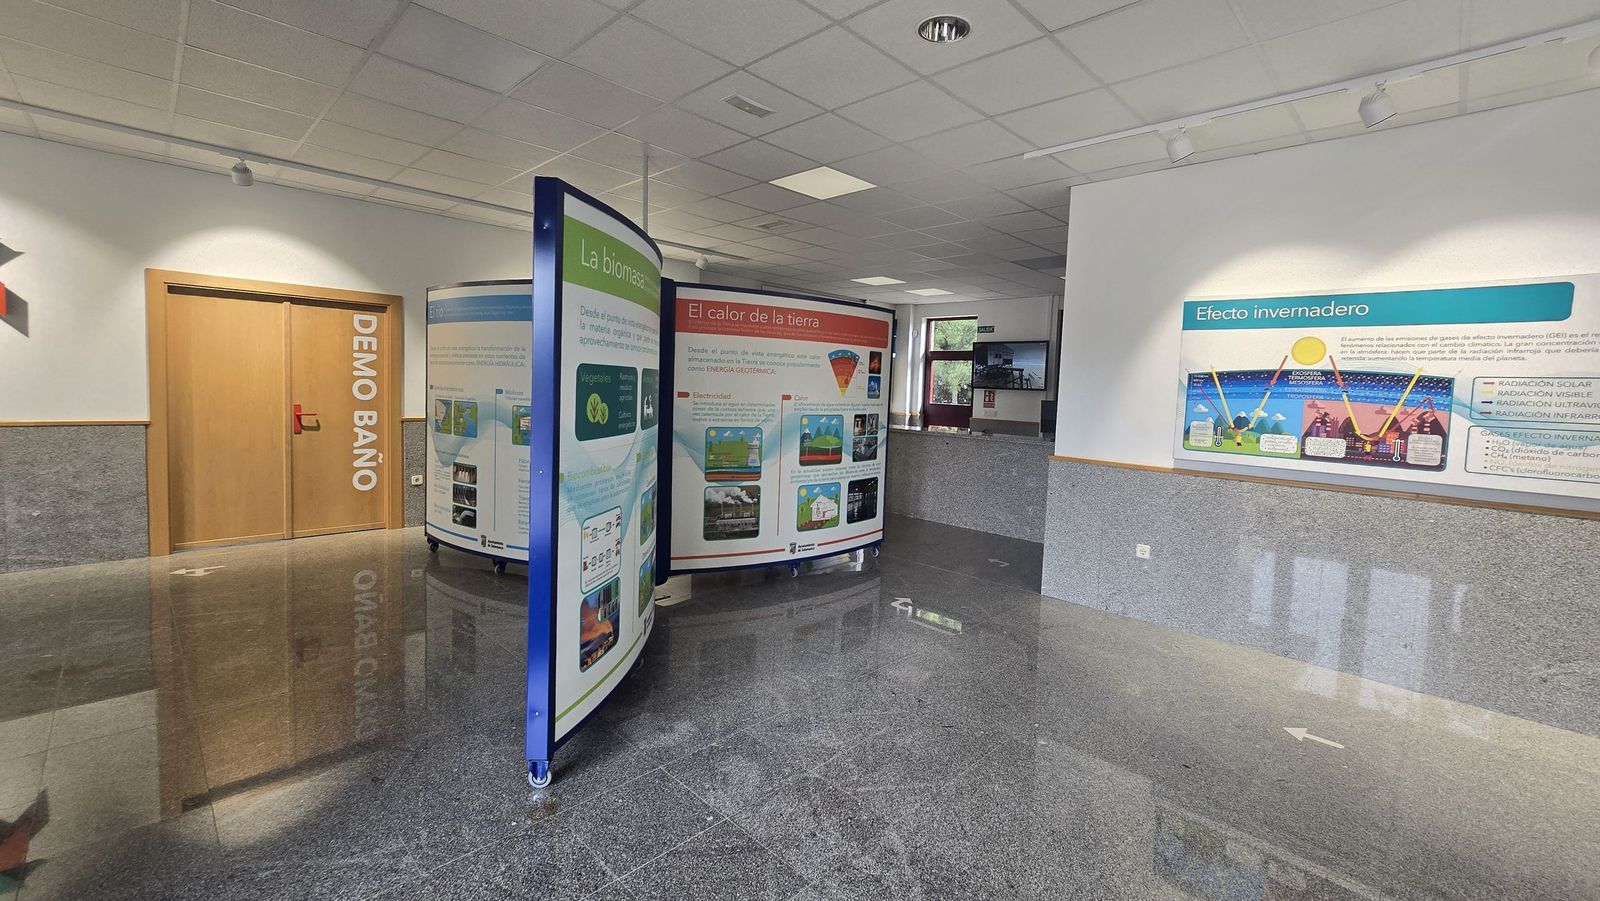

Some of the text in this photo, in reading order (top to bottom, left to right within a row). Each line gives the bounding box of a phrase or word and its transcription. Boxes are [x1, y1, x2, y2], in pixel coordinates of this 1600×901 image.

[580, 238, 646, 289] La biomasa
[580, 304, 600, 319] Desde
[688, 303, 819, 328] El calor de la tierra
[1196, 300, 1370, 321] Efecto invernadero
[579, 319, 586, 330] la
[589, 323, 611, 335] materia
[1546, 332, 1567, 340] (GEI)
[1536, 339, 1597, 347] concentración
[688, 346, 709, 354] Desde
[720, 348, 739, 356] punto
[766, 351, 795, 359] energético
[688, 356, 726, 364] almacenado
[742, 358, 758, 366] Tierra
[706, 365, 735, 373] ENERGÍA
[580, 370, 612, 386] Vegetales
[1498, 380, 1554, 388] RADIACIÓN
[692, 391, 732, 400] Electricidad
[1497, 390, 1594, 399] RADIACIÓN VISIBLE
[352, 313, 384, 492] DEMO BAÑO
[1496, 400, 1552, 408] RADIACIÓN
[1495, 410, 1600, 420] RADIACIÓN INFRARR
[1480, 430, 1600, 442] GASES EFECTO INVERNA
[1511, 447, 1550, 455] (dióxido
[1510, 454, 1551, 462] (metano)
[1516, 467, 1600, 479] (clorofluorocarbo
